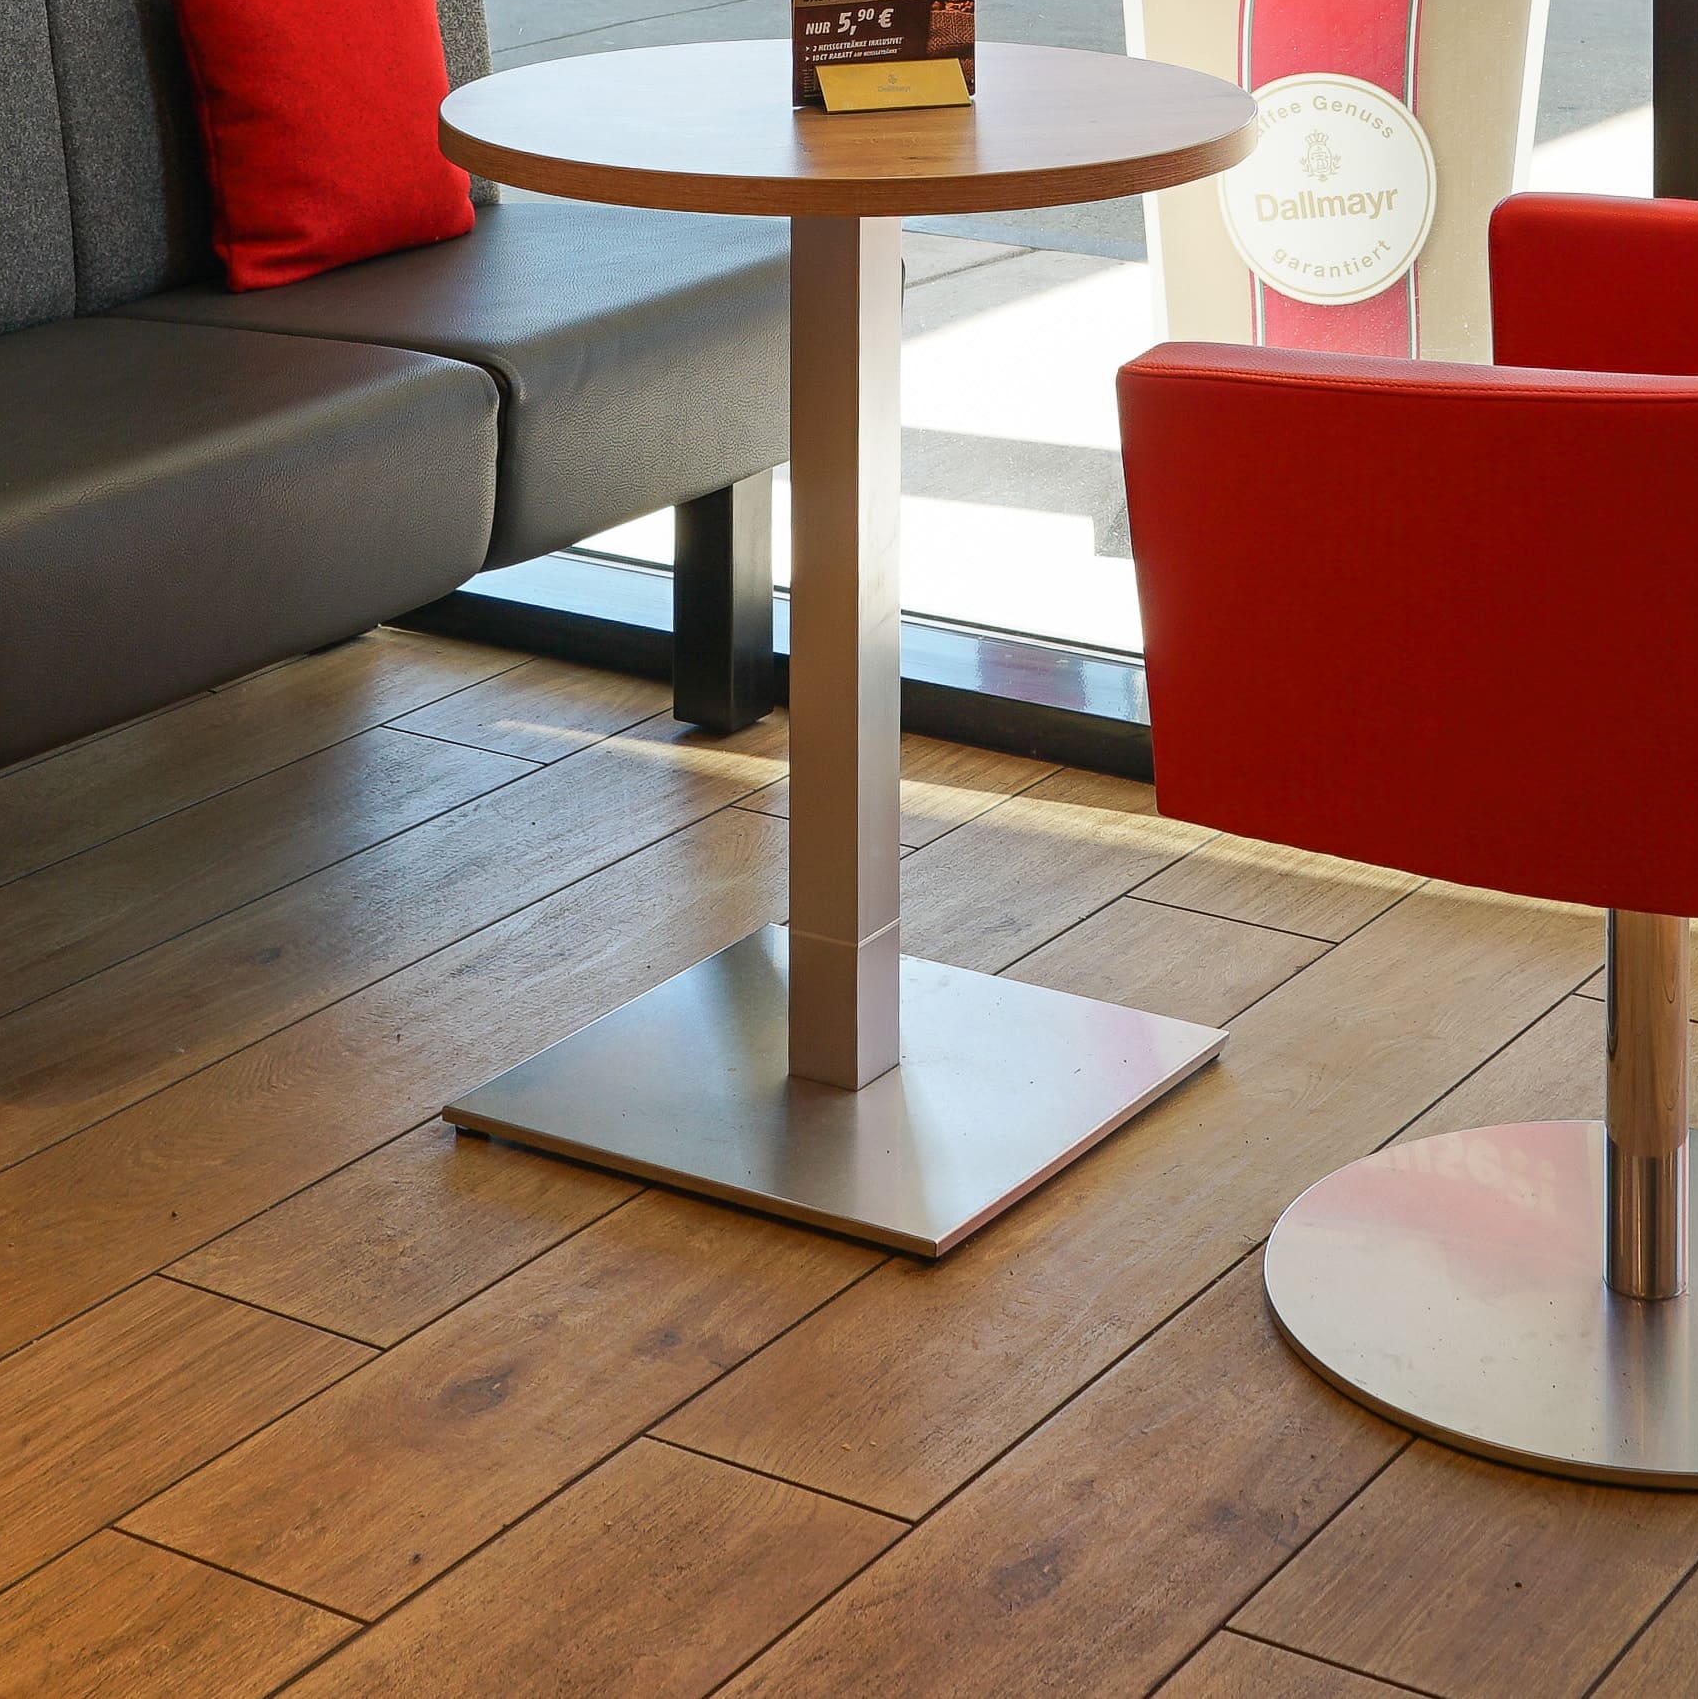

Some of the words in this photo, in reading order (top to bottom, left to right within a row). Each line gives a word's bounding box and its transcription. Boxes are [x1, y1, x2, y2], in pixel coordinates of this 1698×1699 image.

[805, 21, 831, 36] NUR
[878, 8, 894, 29] €
[828, 51, 853, 60] RABATT
[1312, 95, 1394, 139] Genuss
[1255, 188, 1398, 222] Dallmayr
[1273, 239, 1391, 279] garantiert
